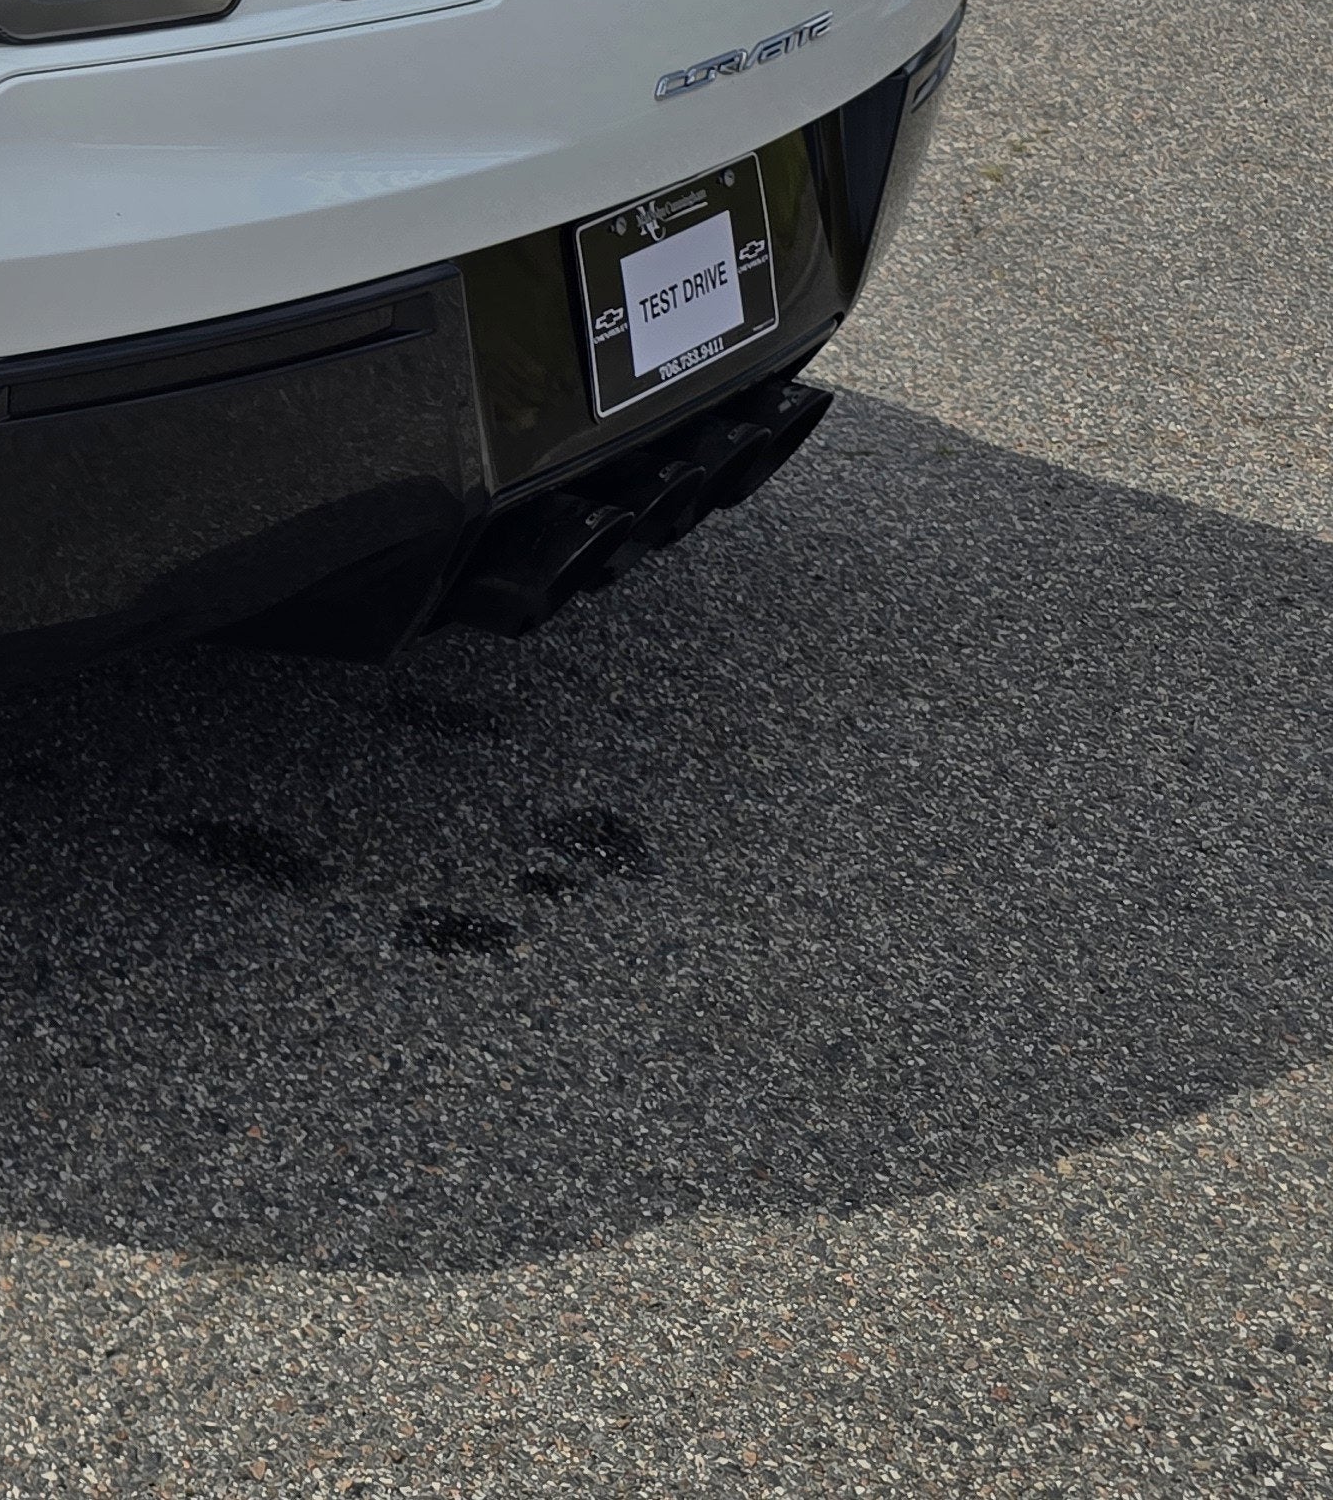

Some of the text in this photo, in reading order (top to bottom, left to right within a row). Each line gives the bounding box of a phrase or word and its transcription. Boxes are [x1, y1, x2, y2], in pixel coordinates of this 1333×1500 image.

[654, 9, 834, 102] CORVETTE
[638, 260, 729, 324] TEST DRIVE
